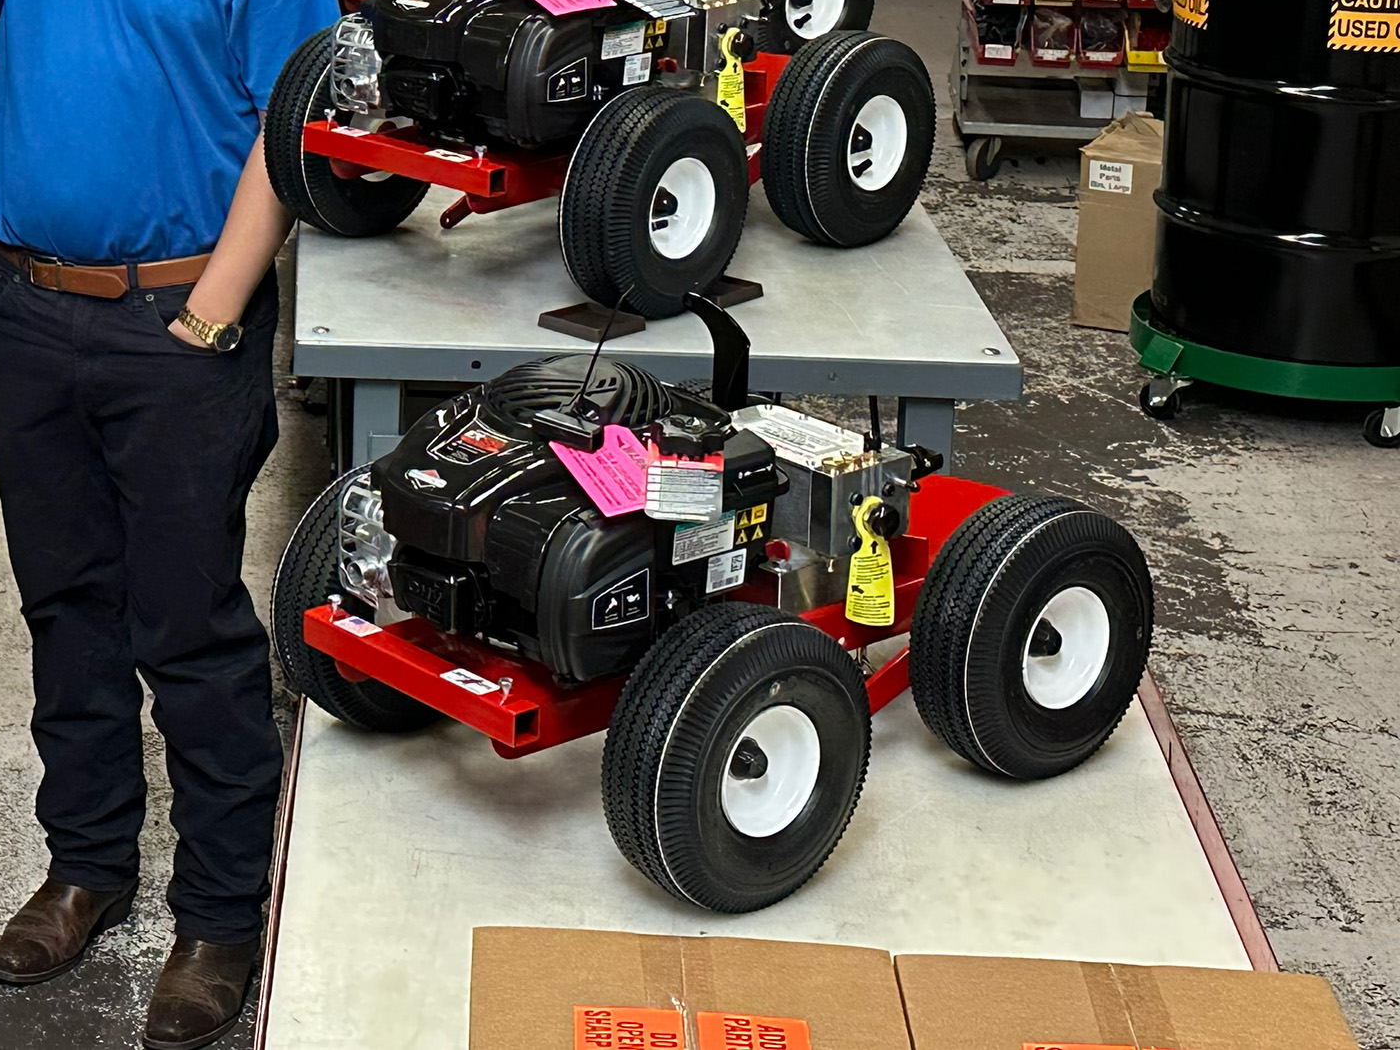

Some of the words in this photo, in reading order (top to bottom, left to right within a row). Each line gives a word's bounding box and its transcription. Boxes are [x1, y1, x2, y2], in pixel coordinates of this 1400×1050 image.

[1337, 19, 1391, 39] USED
[584, 1010, 612, 1048] SHARP
[650, 1032, 678, 1048] DO
[723, 1017, 751, 1050] PART
